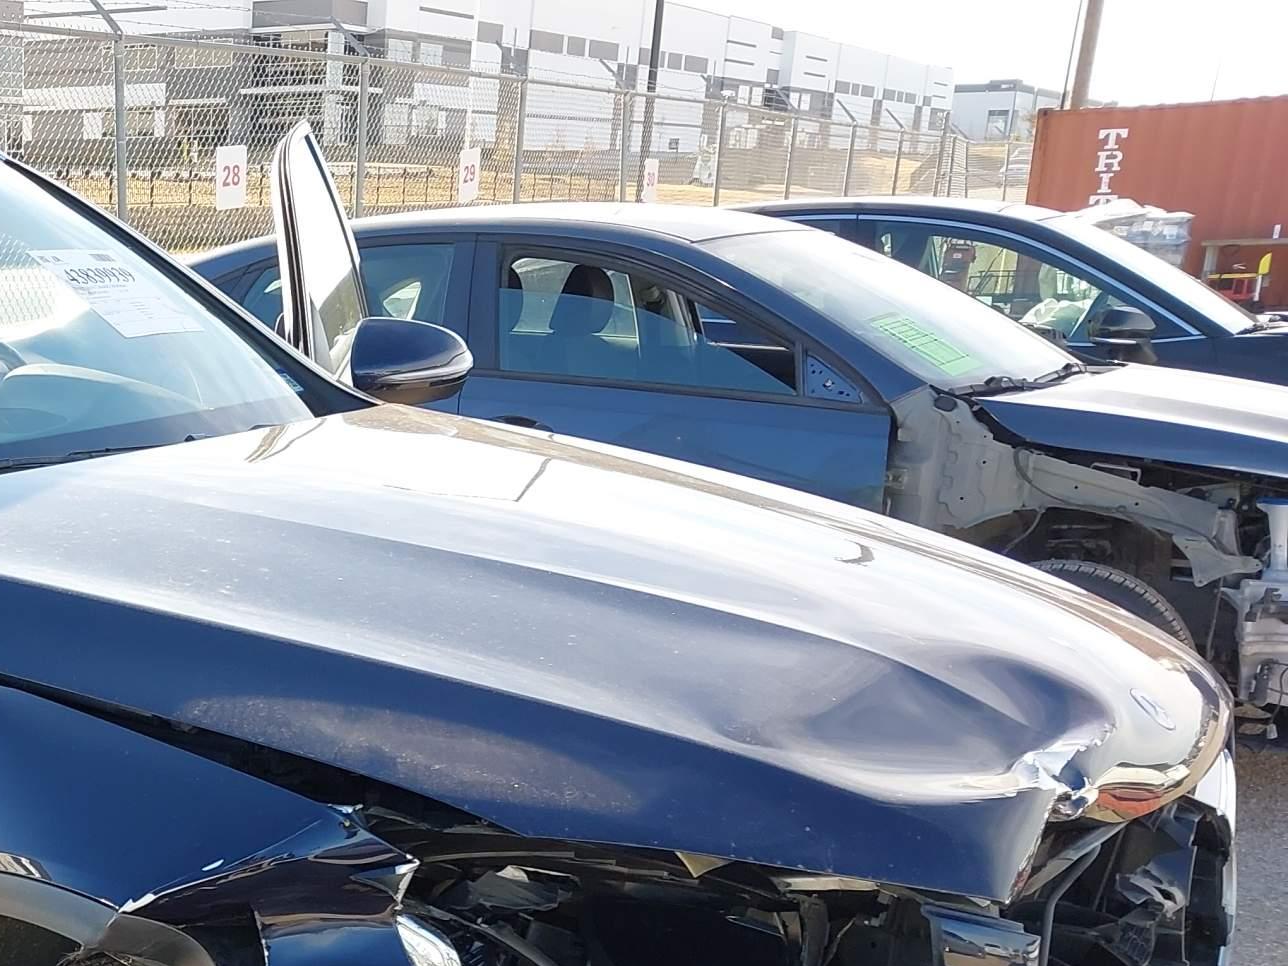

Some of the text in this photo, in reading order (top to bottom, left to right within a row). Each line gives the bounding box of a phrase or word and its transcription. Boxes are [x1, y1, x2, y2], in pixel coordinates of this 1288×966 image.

[222, 164, 240, 187] 28
[463, 164, 475, 184] 29
[64, 267, 135, 285] 43839939
